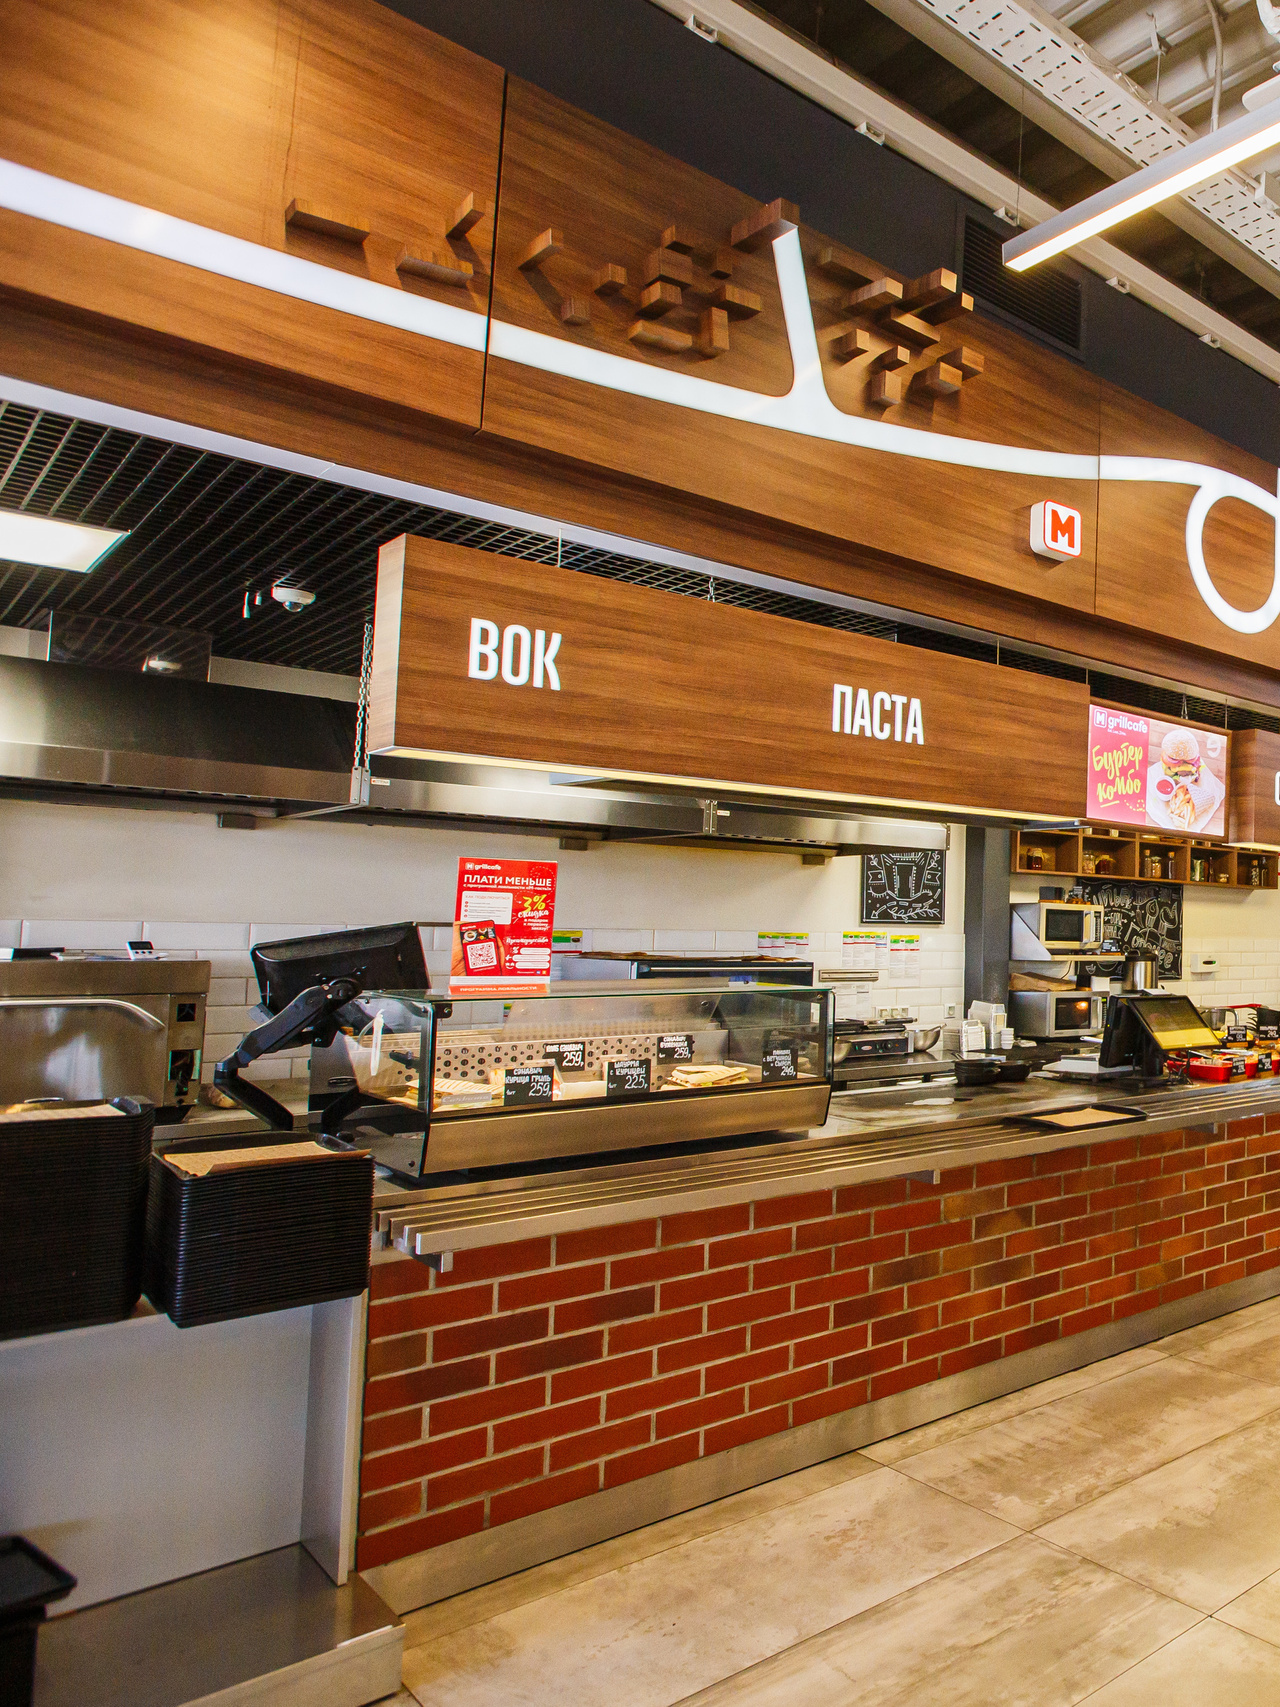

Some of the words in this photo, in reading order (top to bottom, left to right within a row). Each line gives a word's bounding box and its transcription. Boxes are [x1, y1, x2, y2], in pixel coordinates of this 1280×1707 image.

[1050, 508, 1076, 549] M
[467, 617, 563, 691] ВОК
[832, 683, 925, 745] ПАСТА
[1107, 715, 1148, 734] grillcafe
[1092, 742, 1143, 780] Бургер
[463, 874, 503, 884] ПЛАТИ
[505, 876, 552, 887] МЕНЬШЕ
[520, 894, 547, 913] 3%
[513, 1067, 543, 1075] СЭНДВИЧ
[614, 1060, 640, 1068] ШАУРМА
[615, 1065, 647, 1077] КУРИЦЕЙ
[505, 1075, 530, 1085] КУРИЦА
[531, 1074, 552, 1082] ГРИЛЬ
